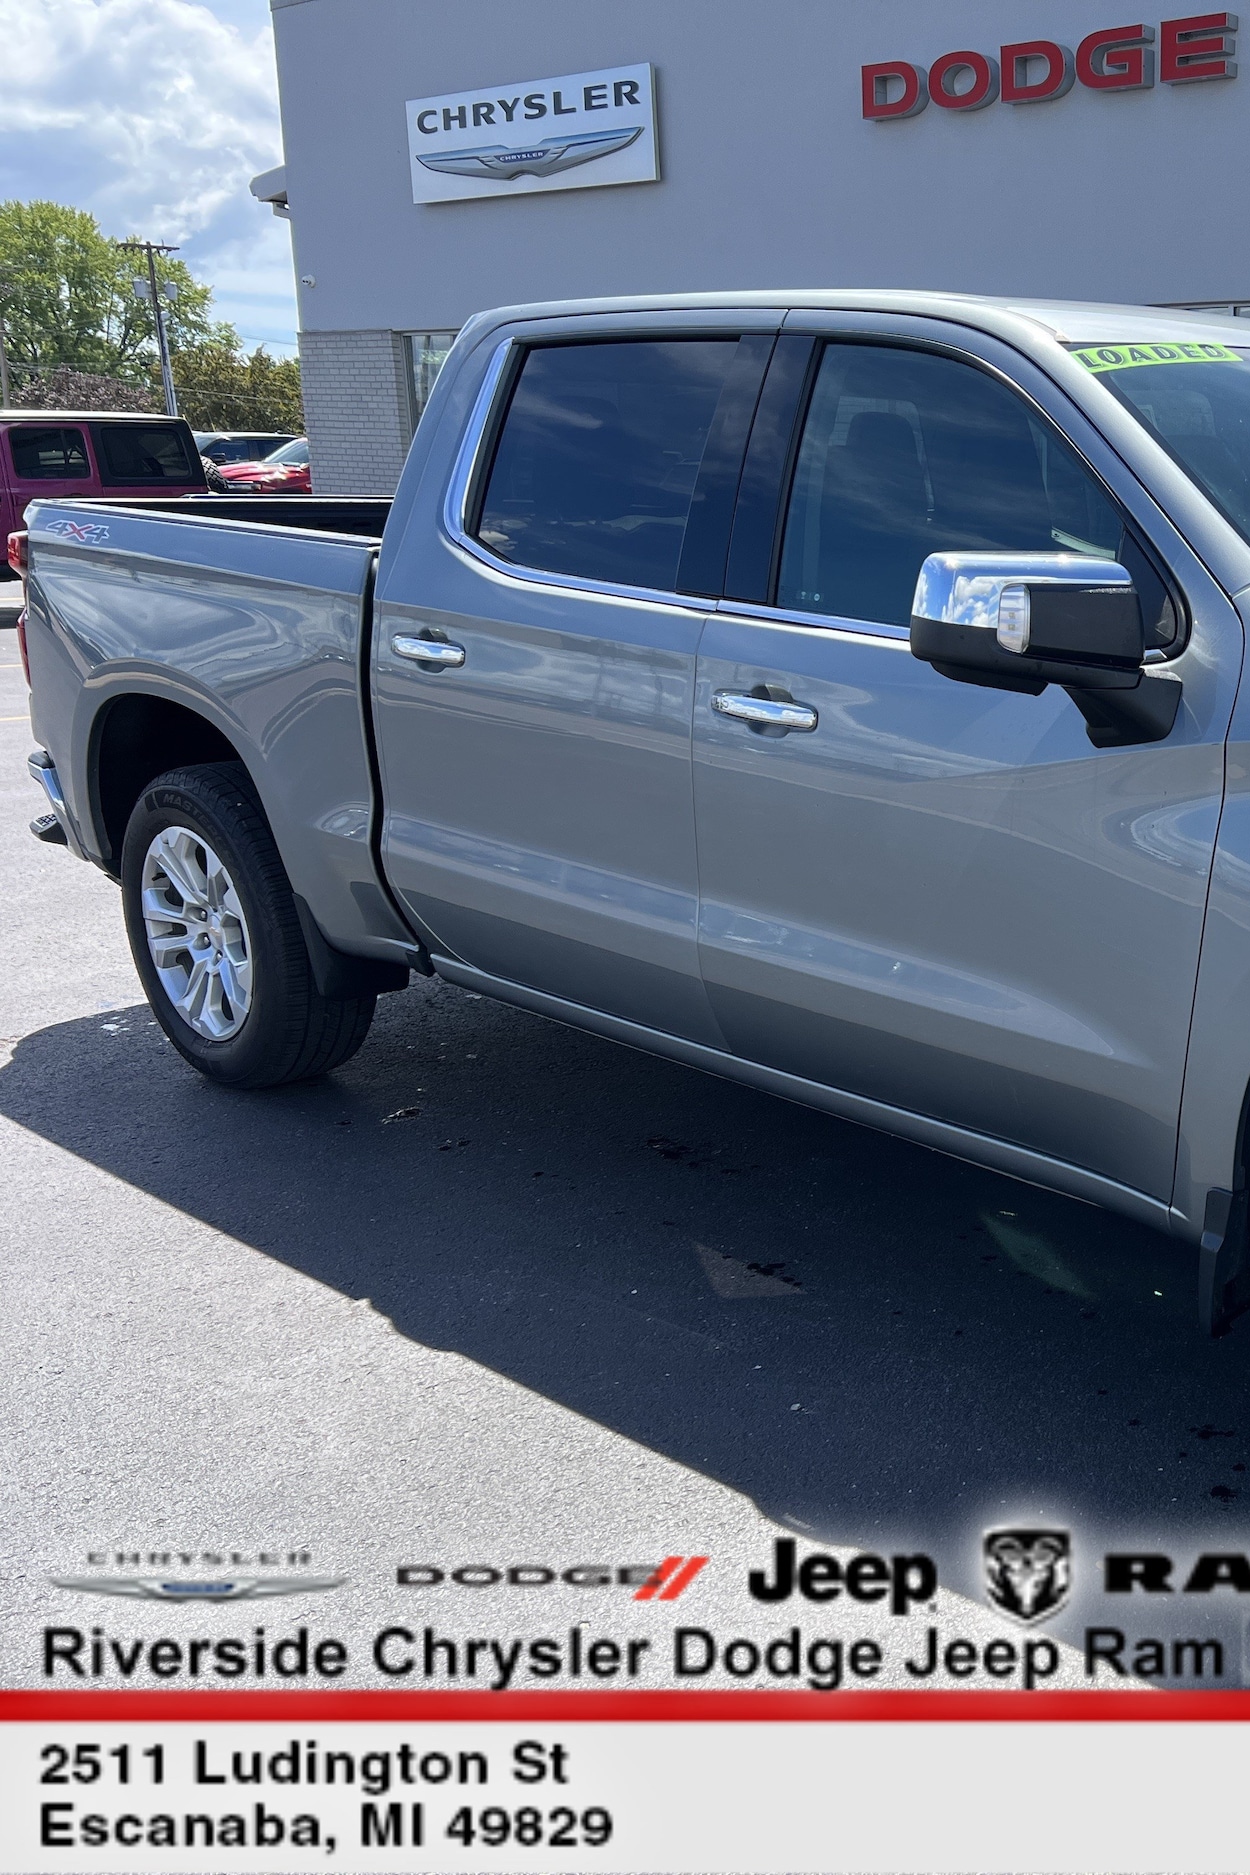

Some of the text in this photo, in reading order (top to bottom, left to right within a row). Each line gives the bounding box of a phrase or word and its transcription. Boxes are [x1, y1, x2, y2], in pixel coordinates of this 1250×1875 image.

[862, 12, 1236, 120] DODGE
[417, 80, 641, 135] CHRYSLER
[499, 151, 545, 162] CHRYSLER
[1076, 343, 1226, 369] LOADED
